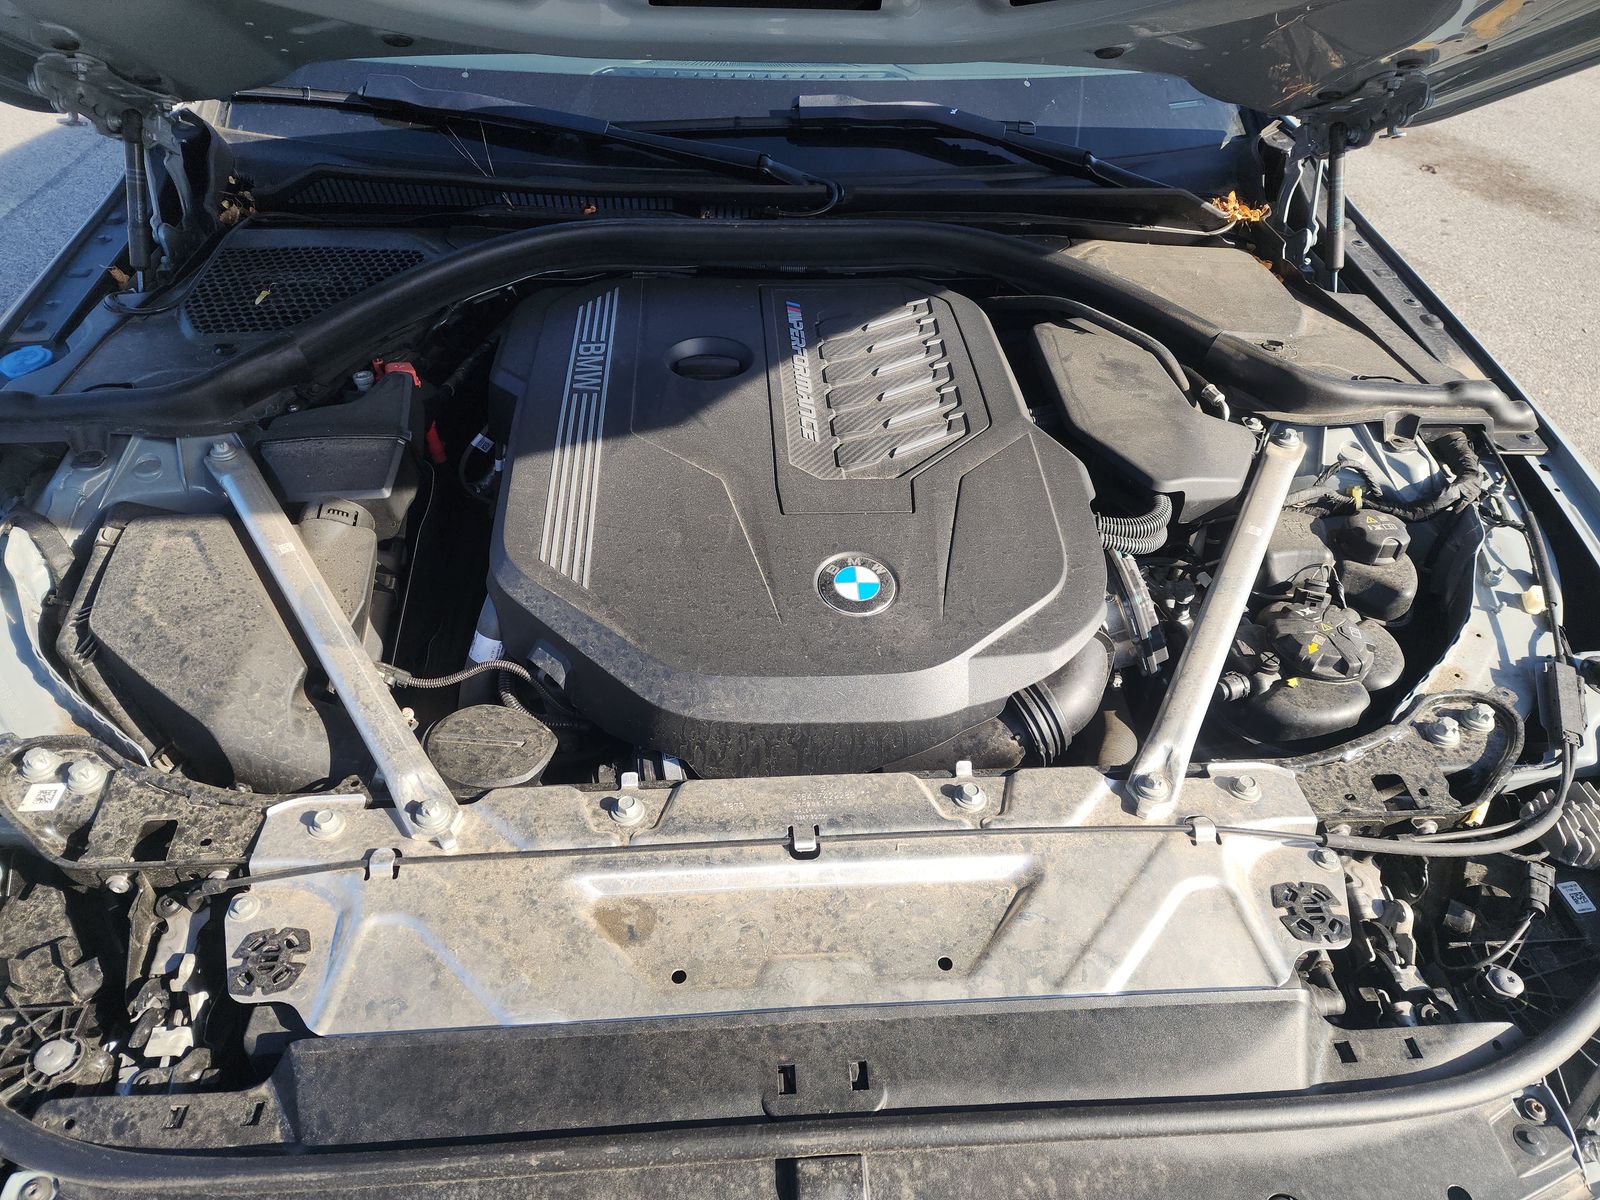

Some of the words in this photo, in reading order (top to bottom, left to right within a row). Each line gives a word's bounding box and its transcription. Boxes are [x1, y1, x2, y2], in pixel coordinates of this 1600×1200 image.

[573, 343, 606, 391] BMW
[789, 321, 819, 442] PERFORMANCE
[826, 557, 887, 576] BMW
